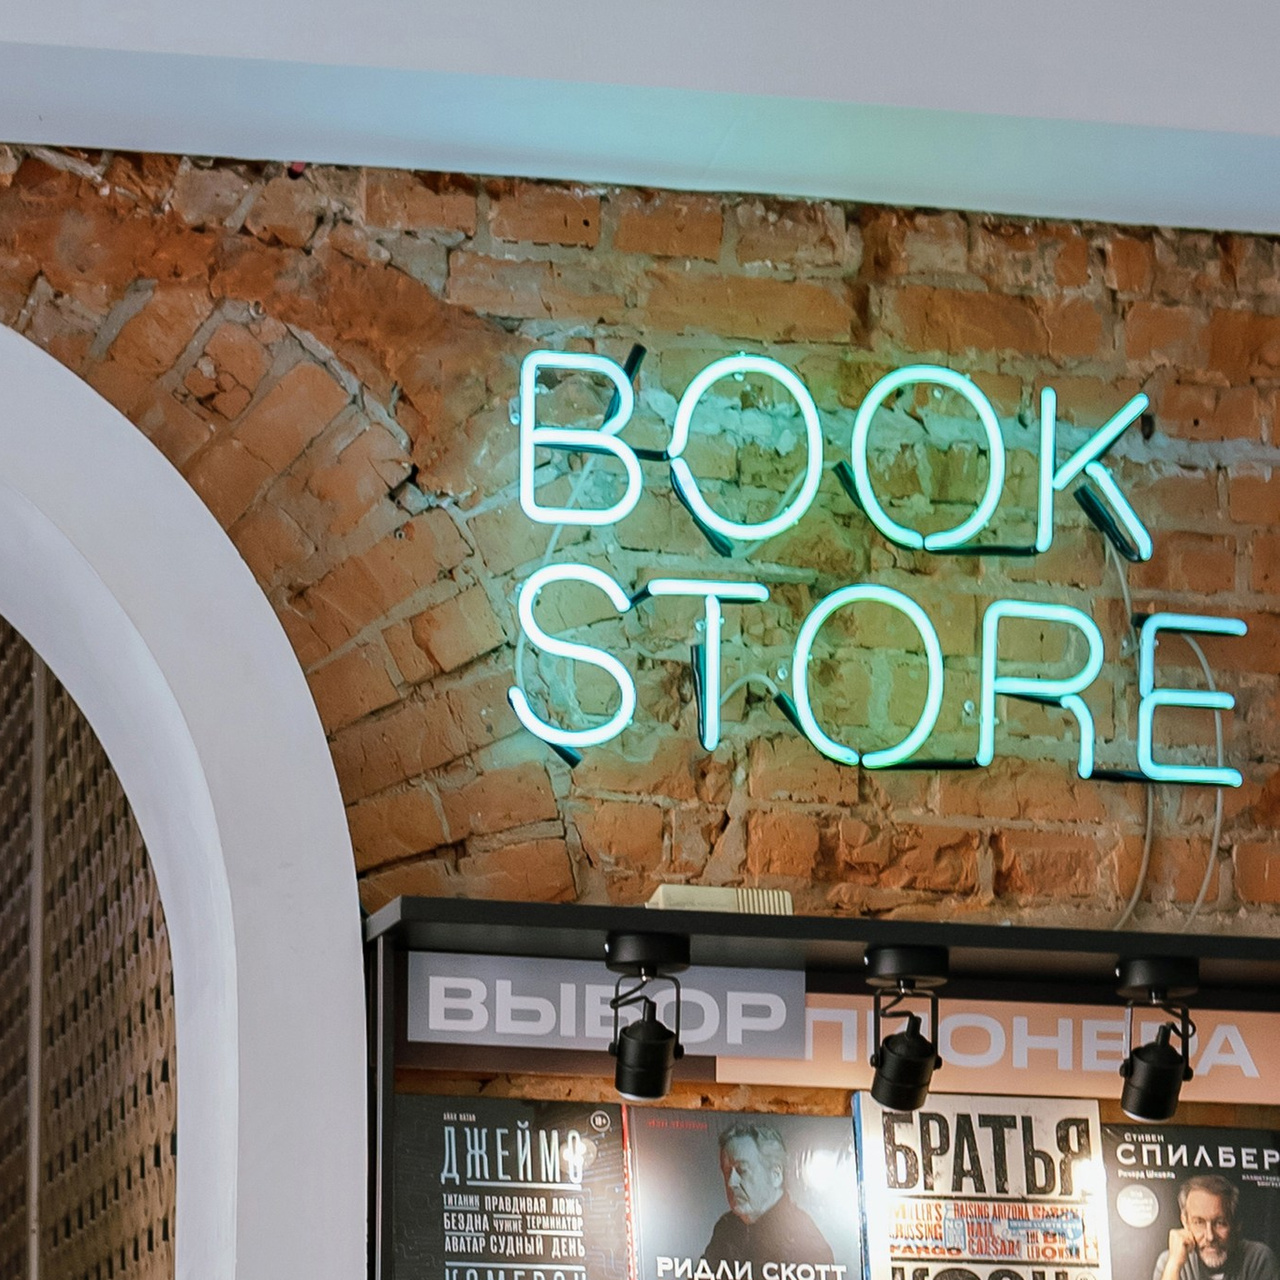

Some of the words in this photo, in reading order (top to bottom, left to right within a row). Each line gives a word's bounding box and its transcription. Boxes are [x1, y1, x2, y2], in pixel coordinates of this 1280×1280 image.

[519, 349, 1154, 562] BOOK
[508, 563, 1248, 788] STORE
[429, 975, 787, 1046] ВЫБОР
[1124, 1132, 1164, 1143] СТИВЕН
[882, 1111, 1092, 1196] БРАТЬЯ
[1116, 1142, 1280, 1171] СПИЛБЕР
[443, 1193, 480, 1207] ТИТАНИК
[485, 1195, 547, 1215] ПРАВДИВАЯ
[552, 1197, 583, 1216] ЛОЖЬ
[953, 1203, 990, 1220] RAISING
[992, 1204, 1030, 1221] ARIZONA
[443, 1213, 490, 1232] БЕЗДНА
[493, 1220, 523, 1233] ЧУЖИЕ
[526, 1215, 584, 1231] ТЕРМИНАТОР
[445, 1236, 486, 1254] АВАТАР
[490, 1235, 544, 1258] СУДНЫЙ
[552, 1237, 586, 1259] ДЕНЬ
